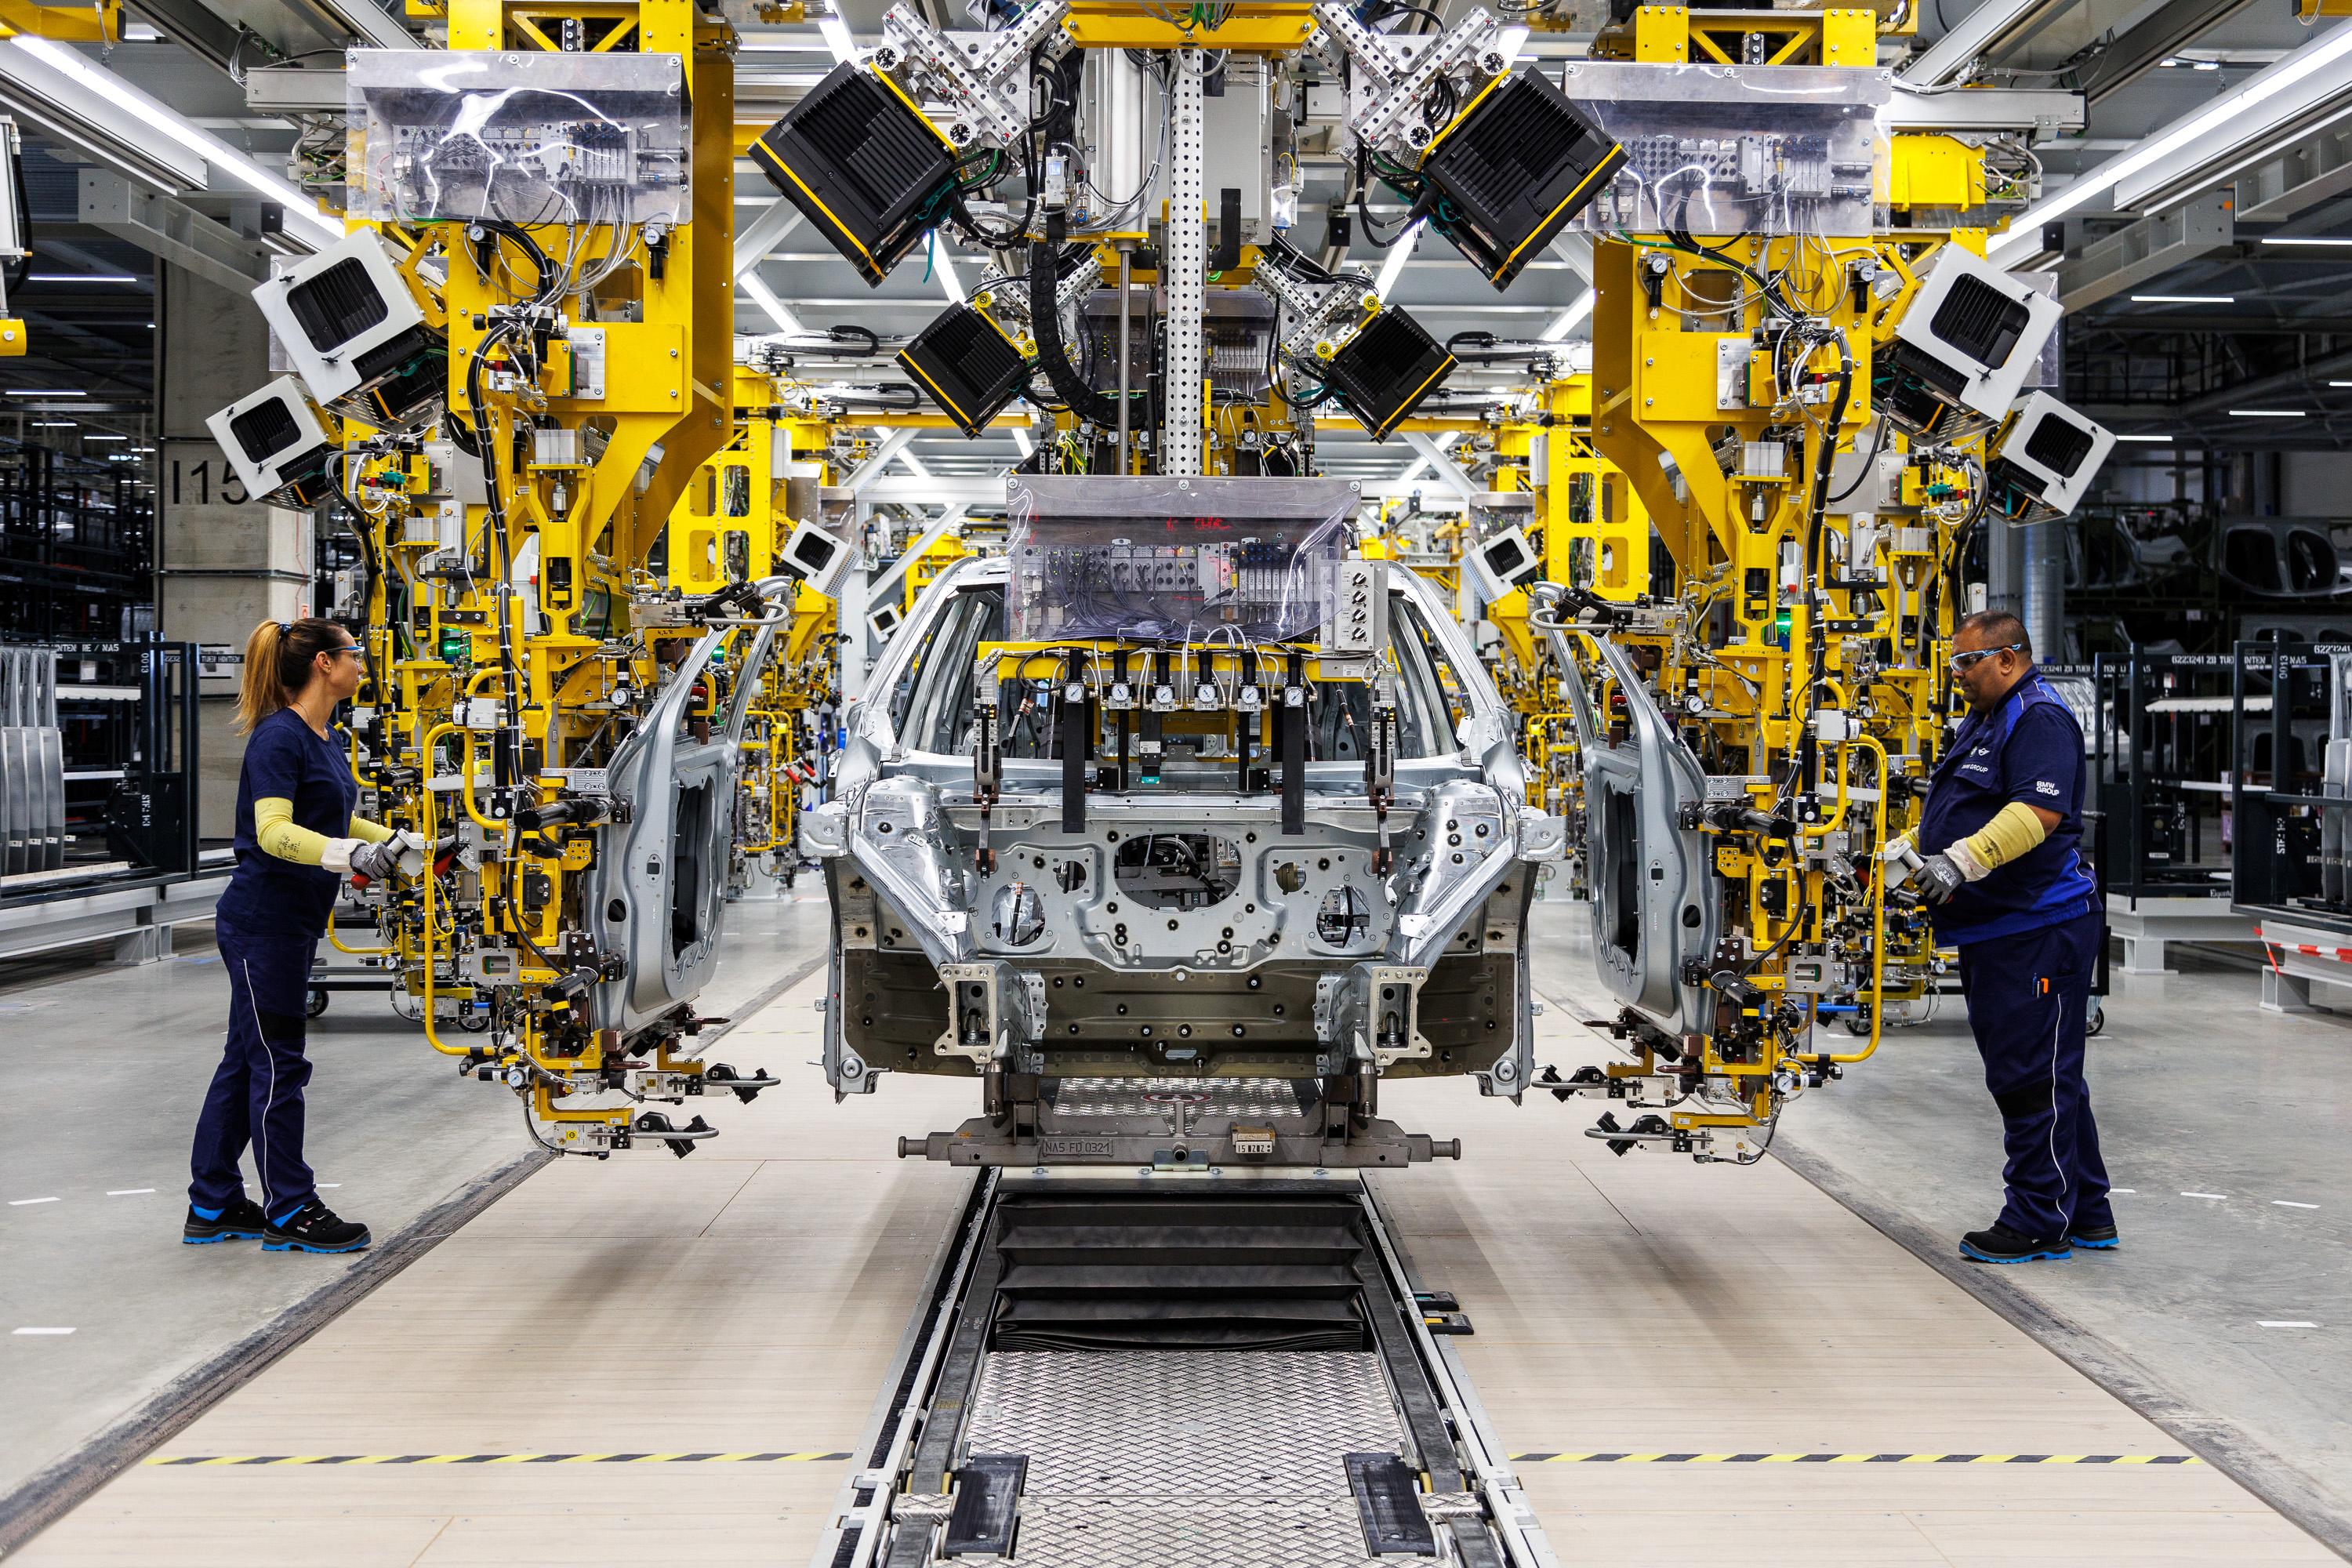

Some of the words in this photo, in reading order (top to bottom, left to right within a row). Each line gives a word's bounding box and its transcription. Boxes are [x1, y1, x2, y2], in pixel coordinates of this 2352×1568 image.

[173, 460, 249, 505] I15
[82, 644, 92, 652] RE
[141, 652, 151, 673] 0013
[2279, 655, 2288, 679] 0013
[1970, 764, 1988, 773] GROUP
[2036, 781, 2055, 789] BMW
[2036, 786, 2060, 796] GROUP
[1069, 1142, 1083, 1152] FD
[1084, 1142, 1110, 1152] 0321
